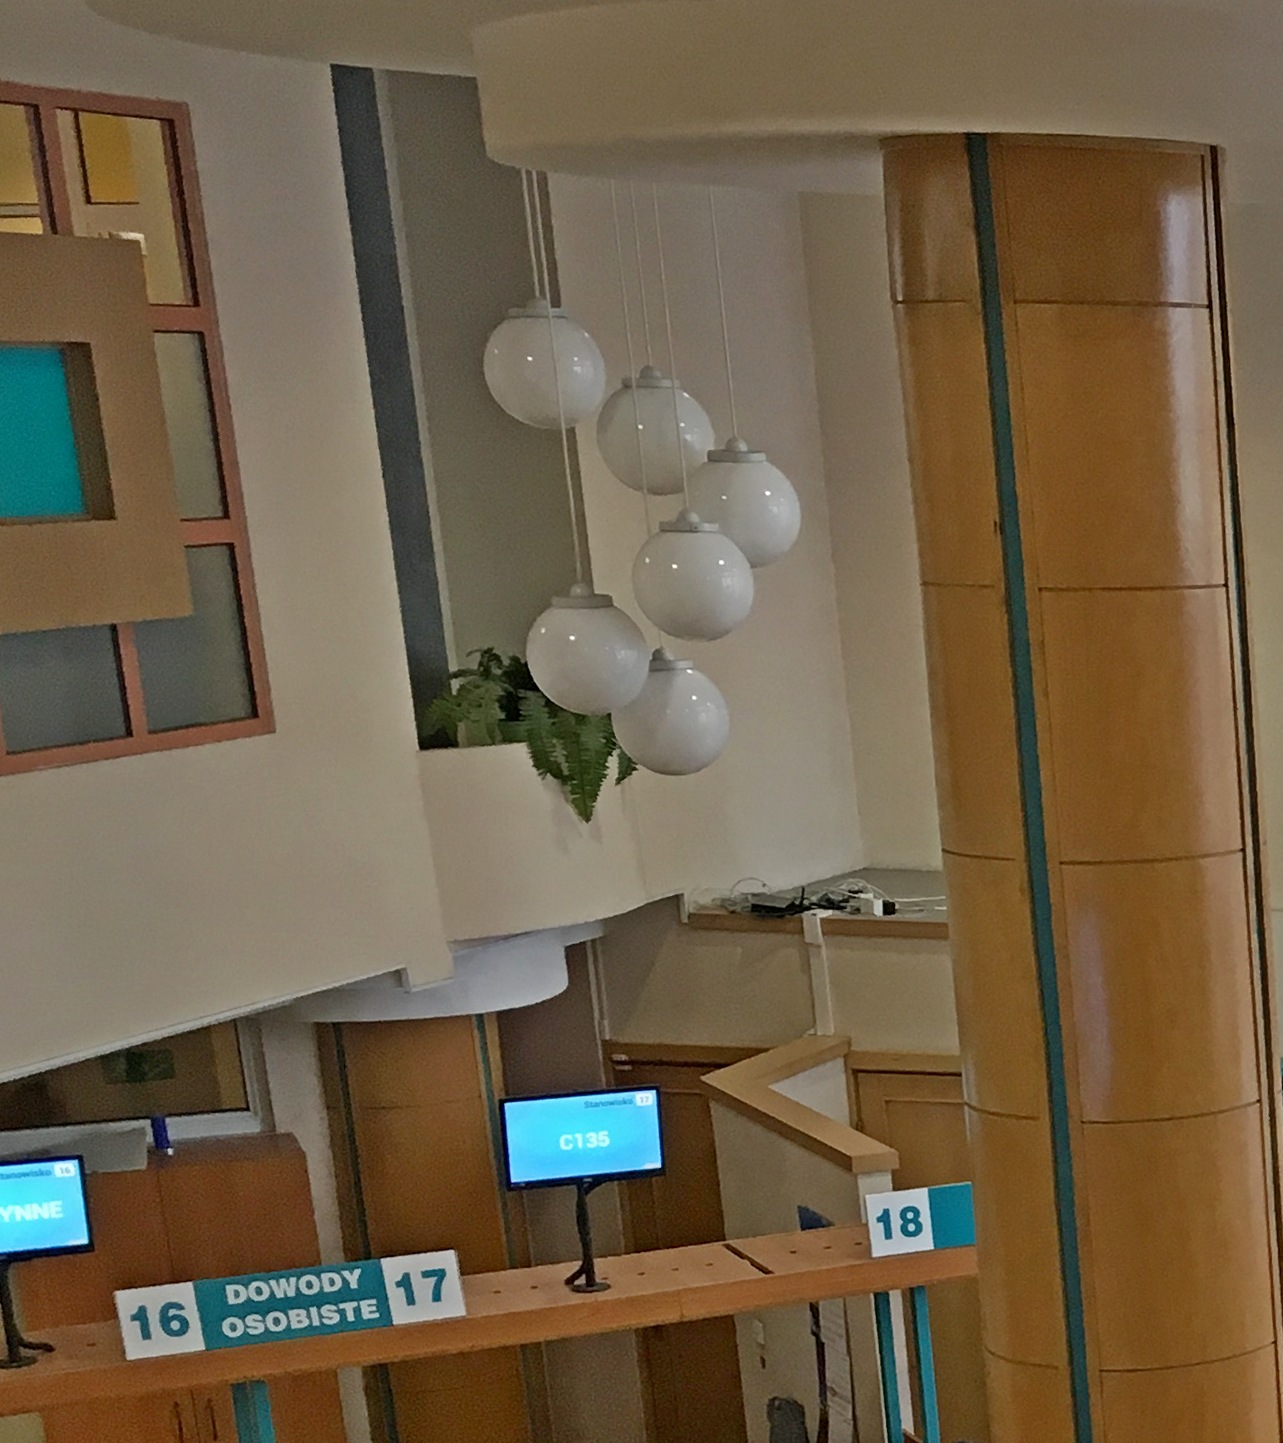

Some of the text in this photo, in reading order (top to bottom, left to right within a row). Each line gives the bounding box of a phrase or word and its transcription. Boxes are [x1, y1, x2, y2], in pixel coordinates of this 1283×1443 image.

[584, 1097, 634, 1109] Stanowisko
[559, 1130, 611, 1151] C135
[0, 1166, 72, 1180] tanowisko 16
[876, 1205, 924, 1241] 18
[224, 1268, 362, 1305] DOWODY
[394, 1268, 448, 1307] 17
[129, 1301, 190, 1341] 16
[221, 1299, 381, 1339] OSOBISTE
